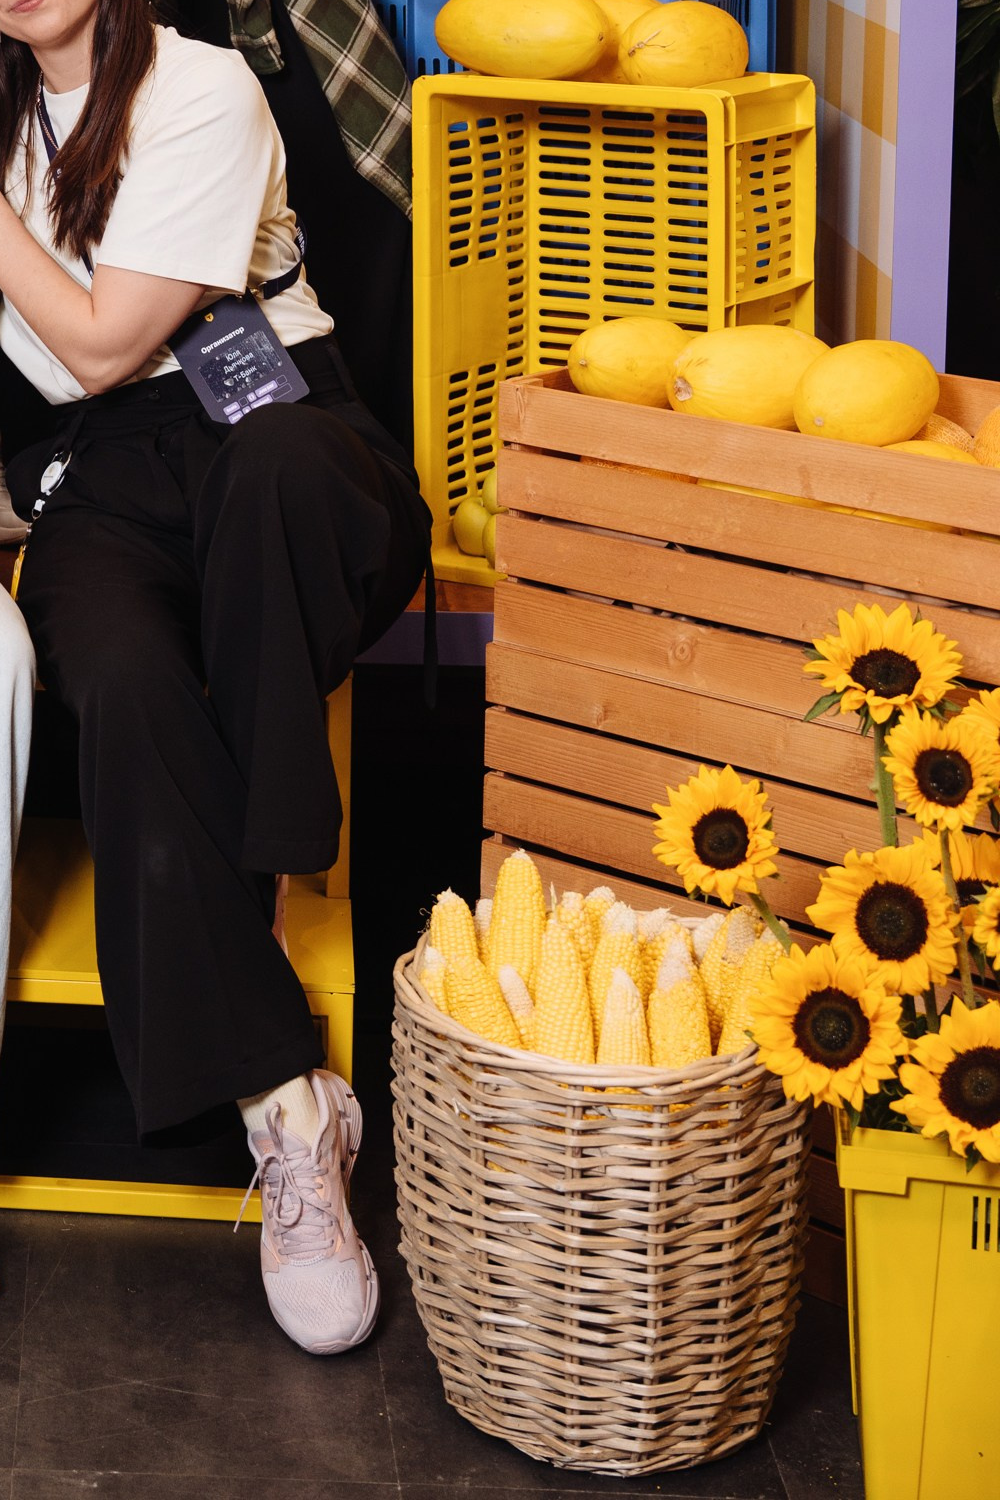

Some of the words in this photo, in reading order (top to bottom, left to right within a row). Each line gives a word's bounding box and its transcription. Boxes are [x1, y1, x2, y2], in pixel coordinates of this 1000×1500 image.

[200, 326, 245, 354] Организатор
[225, 349, 242, 361] Юля
[233, 365, 258, 382] Т-Банк
